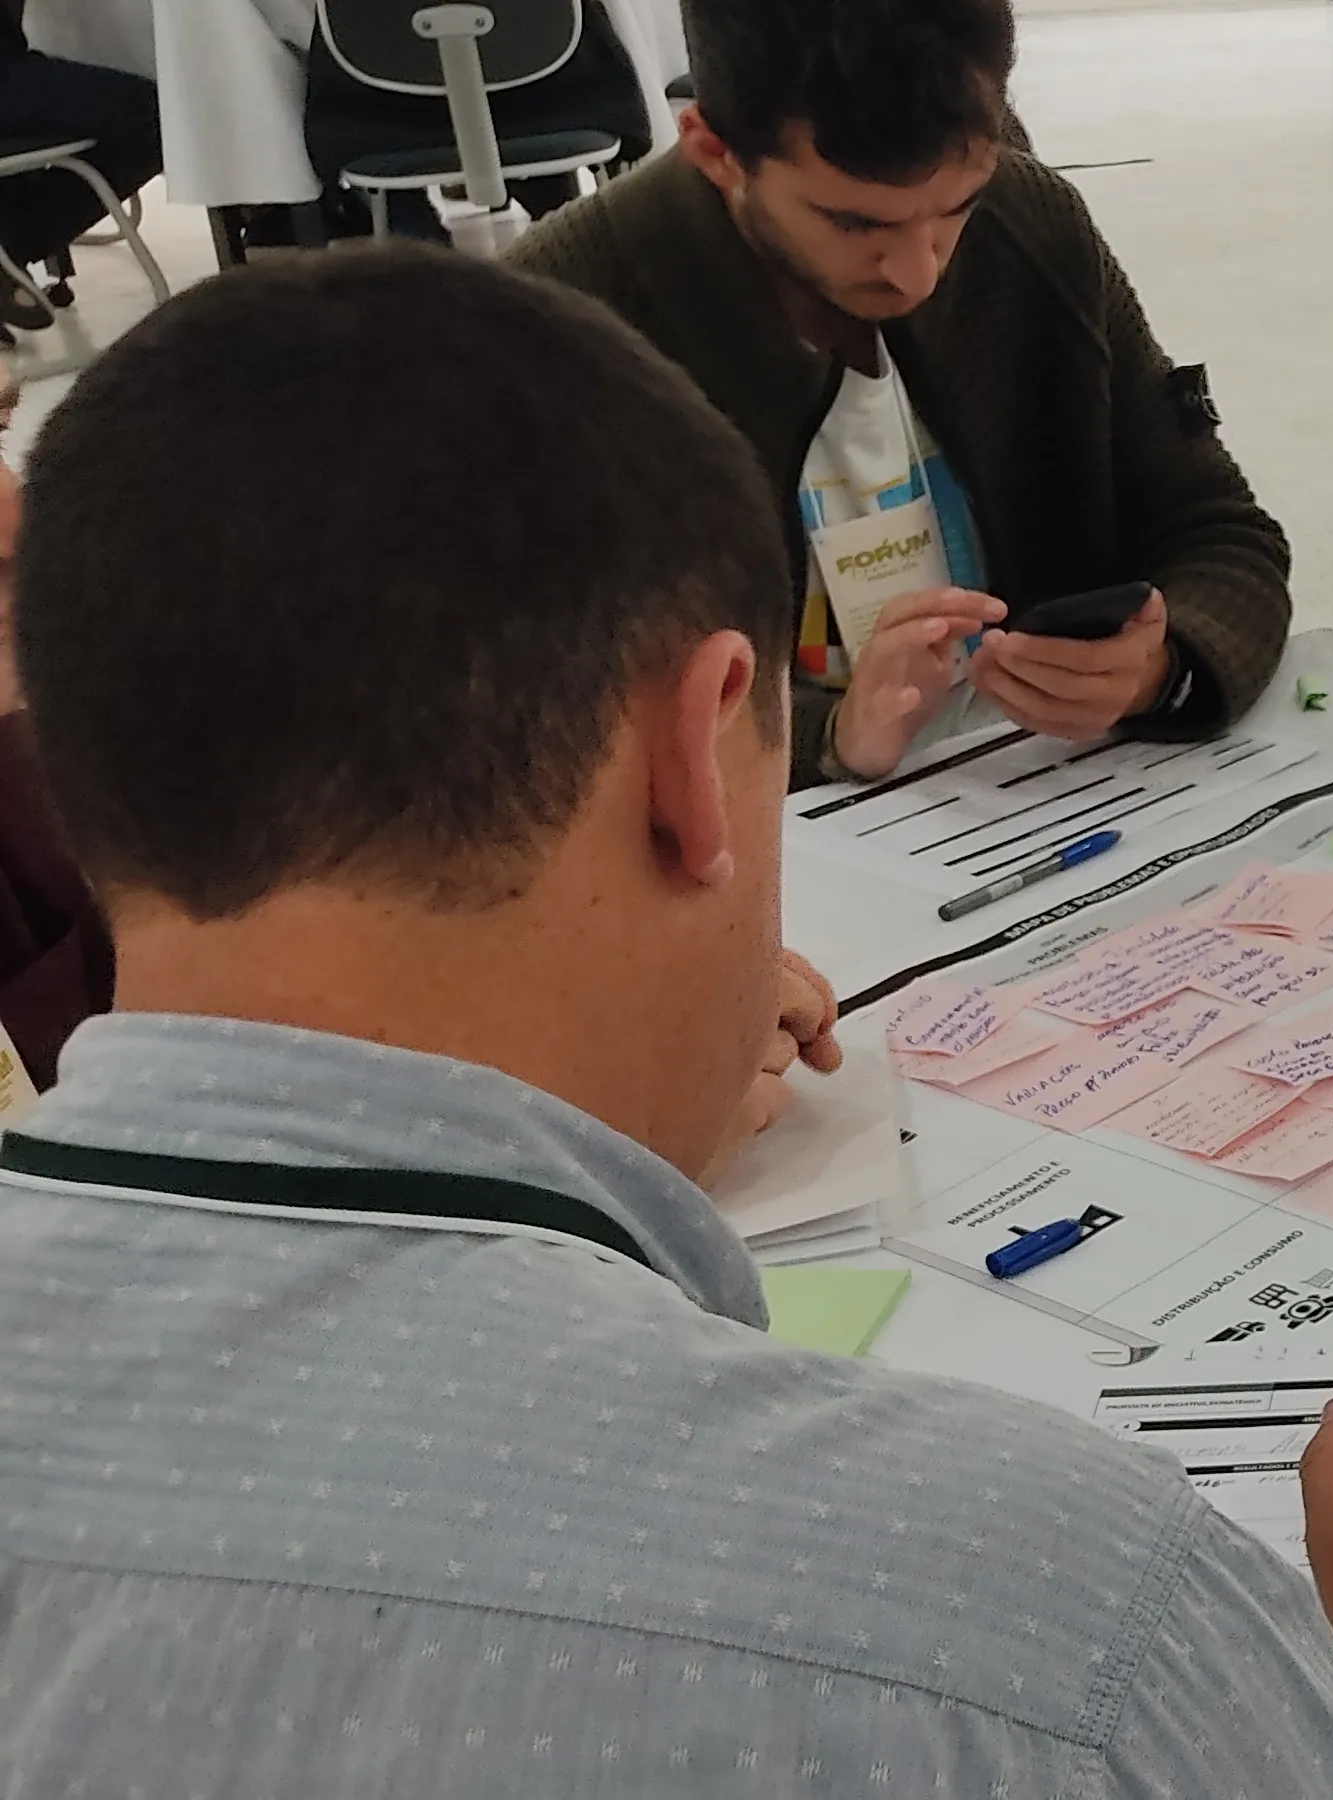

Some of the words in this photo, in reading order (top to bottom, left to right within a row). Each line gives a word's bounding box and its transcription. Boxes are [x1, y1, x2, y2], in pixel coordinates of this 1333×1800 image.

[947, 1165, 1051, 1226] BENEFICIAMENTO
[1049, 1160, 1061, 1168] E
[967, 1168, 1072, 1228] PROCESSAMENTO
[1151, 1275, 1236, 1327] DISTRIBUIÇÃO
[1243, 1230, 1304, 1270] CONSUMO
